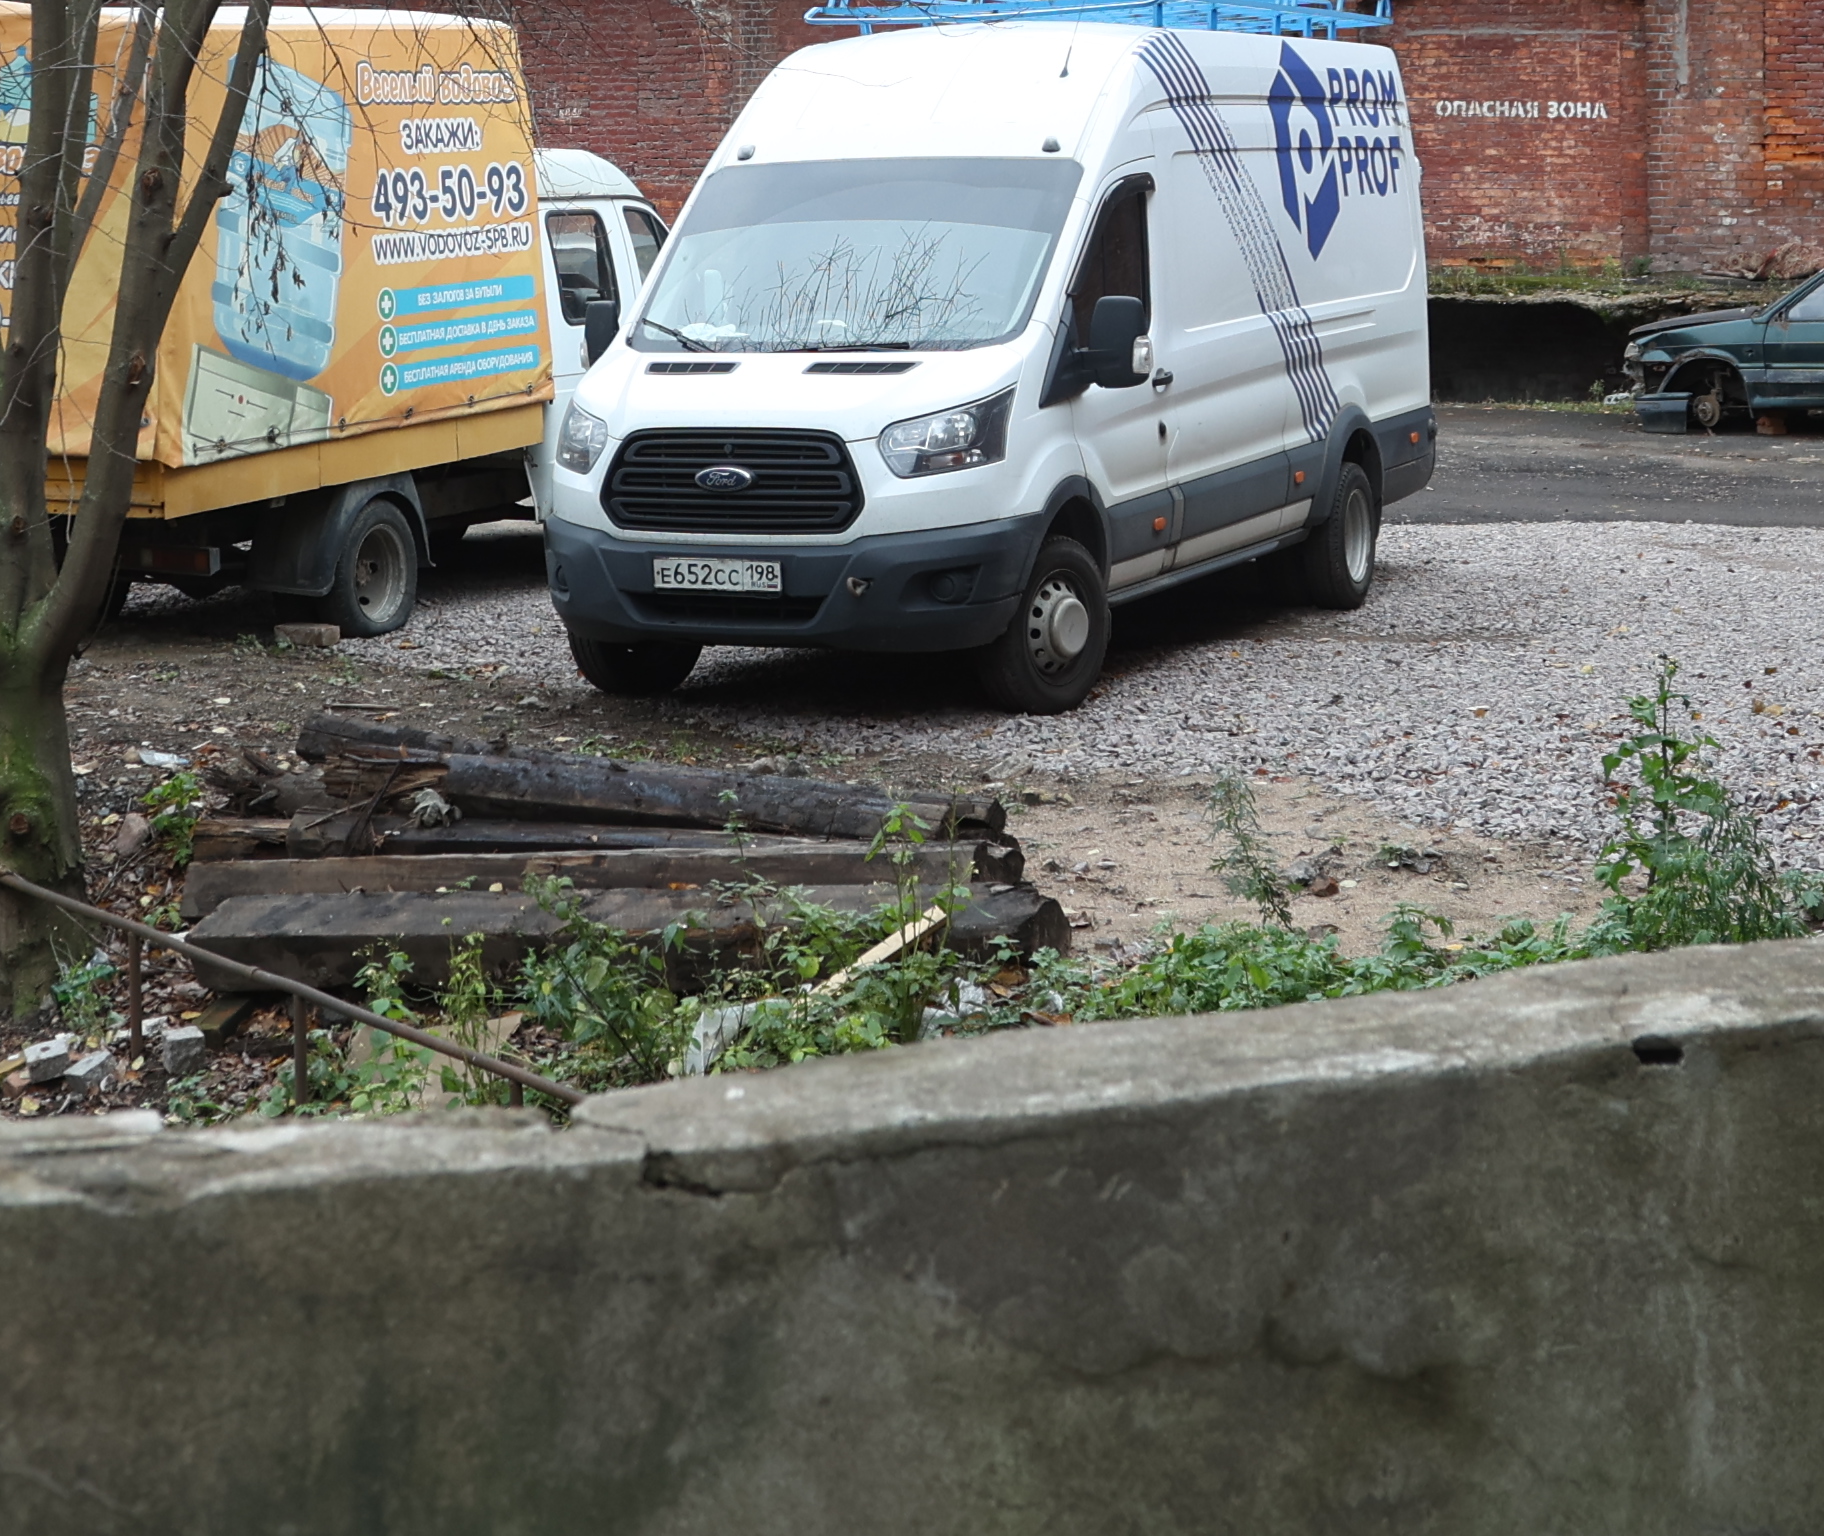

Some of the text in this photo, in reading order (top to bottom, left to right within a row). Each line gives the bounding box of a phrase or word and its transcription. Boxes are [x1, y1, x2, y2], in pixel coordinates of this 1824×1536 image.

[357, 62, 436, 104] Веселый
[1326, 67, 1402, 128] PROM
[1436, 100, 1608, 119] ОПАСНАЯ ЗОНА
[400, 119, 481, 153] ЗАКАЖИ:
[1337, 135, 1401, 197] PROF
[374, 163, 528, 224] 493-50-93
[375, 225, 530, 261] WWW.VODOVOZ-SPB.RU
[417, 284, 503, 306] БЕЗ ЗАЛОГОВ ЗА БУТЫЛИ
[398, 327, 445, 346] БЕСПЛАТНАЯ
[446, 324, 481, 341] ДОСТАВКА
[487, 320, 506, 335] ДЕНЬ
[506, 315, 535, 331] ЗАКАЗА
[403, 351, 534, 384] БЕСПЛАТНАЯ АРЕНДА ОБОРУДОВАНИЯ
[706, 471, 737, 486] Ford
[660, 563, 775, 586] Е652СС 198
